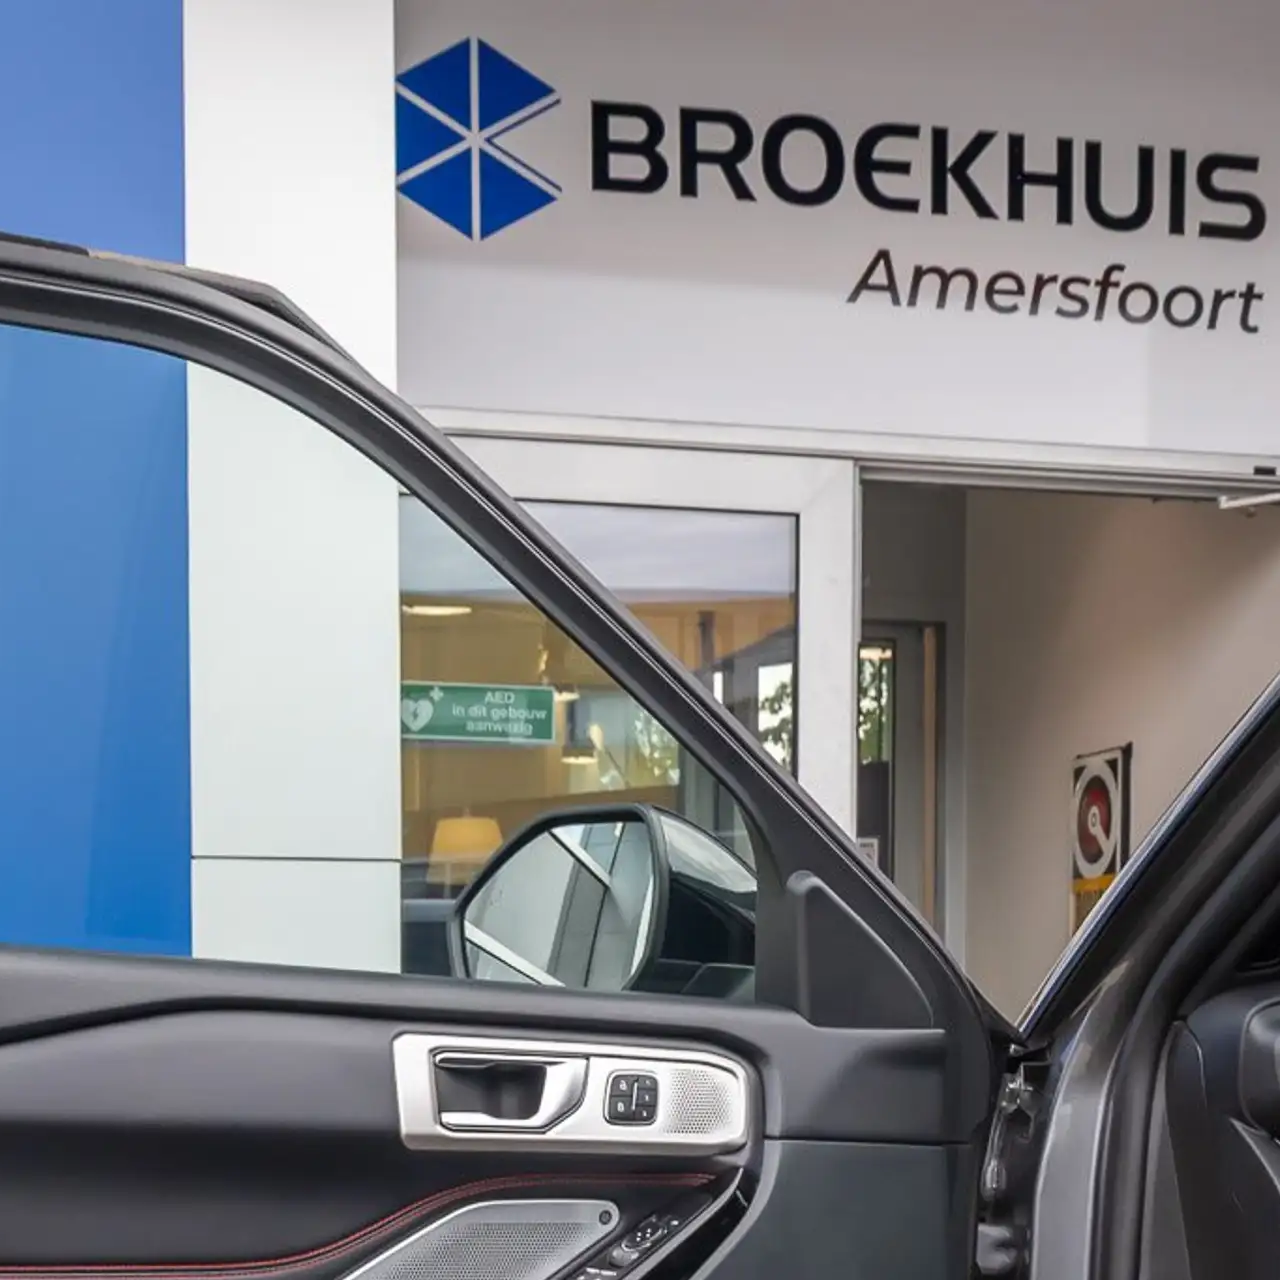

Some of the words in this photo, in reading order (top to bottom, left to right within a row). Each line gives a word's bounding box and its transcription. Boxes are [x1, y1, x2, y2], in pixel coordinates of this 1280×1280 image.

[590, 99, 1267, 241] BROEKHUIS
[846, 249, 1265, 334] Amersfoort
[468, 704, 487, 717] dit
[490, 706, 548, 721] gebouw
[485, 691, 515, 704] AED
